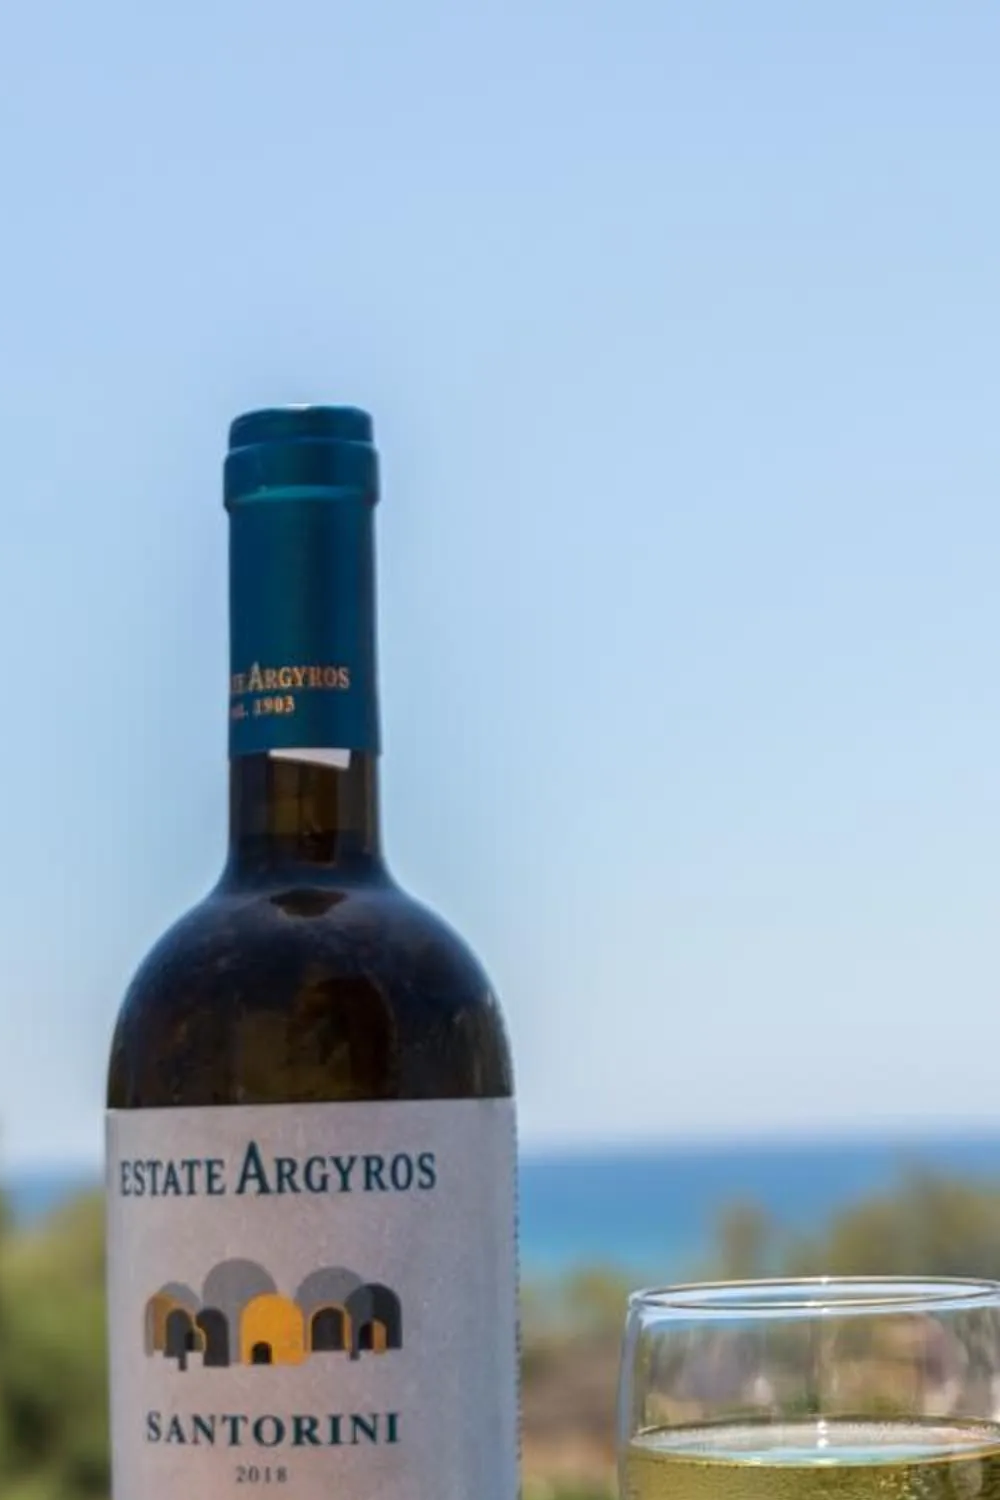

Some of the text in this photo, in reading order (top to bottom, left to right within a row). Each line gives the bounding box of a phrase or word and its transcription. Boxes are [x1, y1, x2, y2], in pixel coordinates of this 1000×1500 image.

[250, 660, 350, 690] ARGYROS
[253, 695, 295, 716] 1903
[120, 1140, 436, 1196] ESTATE ARGYROS
[146, 1410, 400, 1447] SANTORINI
[235, 1465, 288, 1484] 2018
